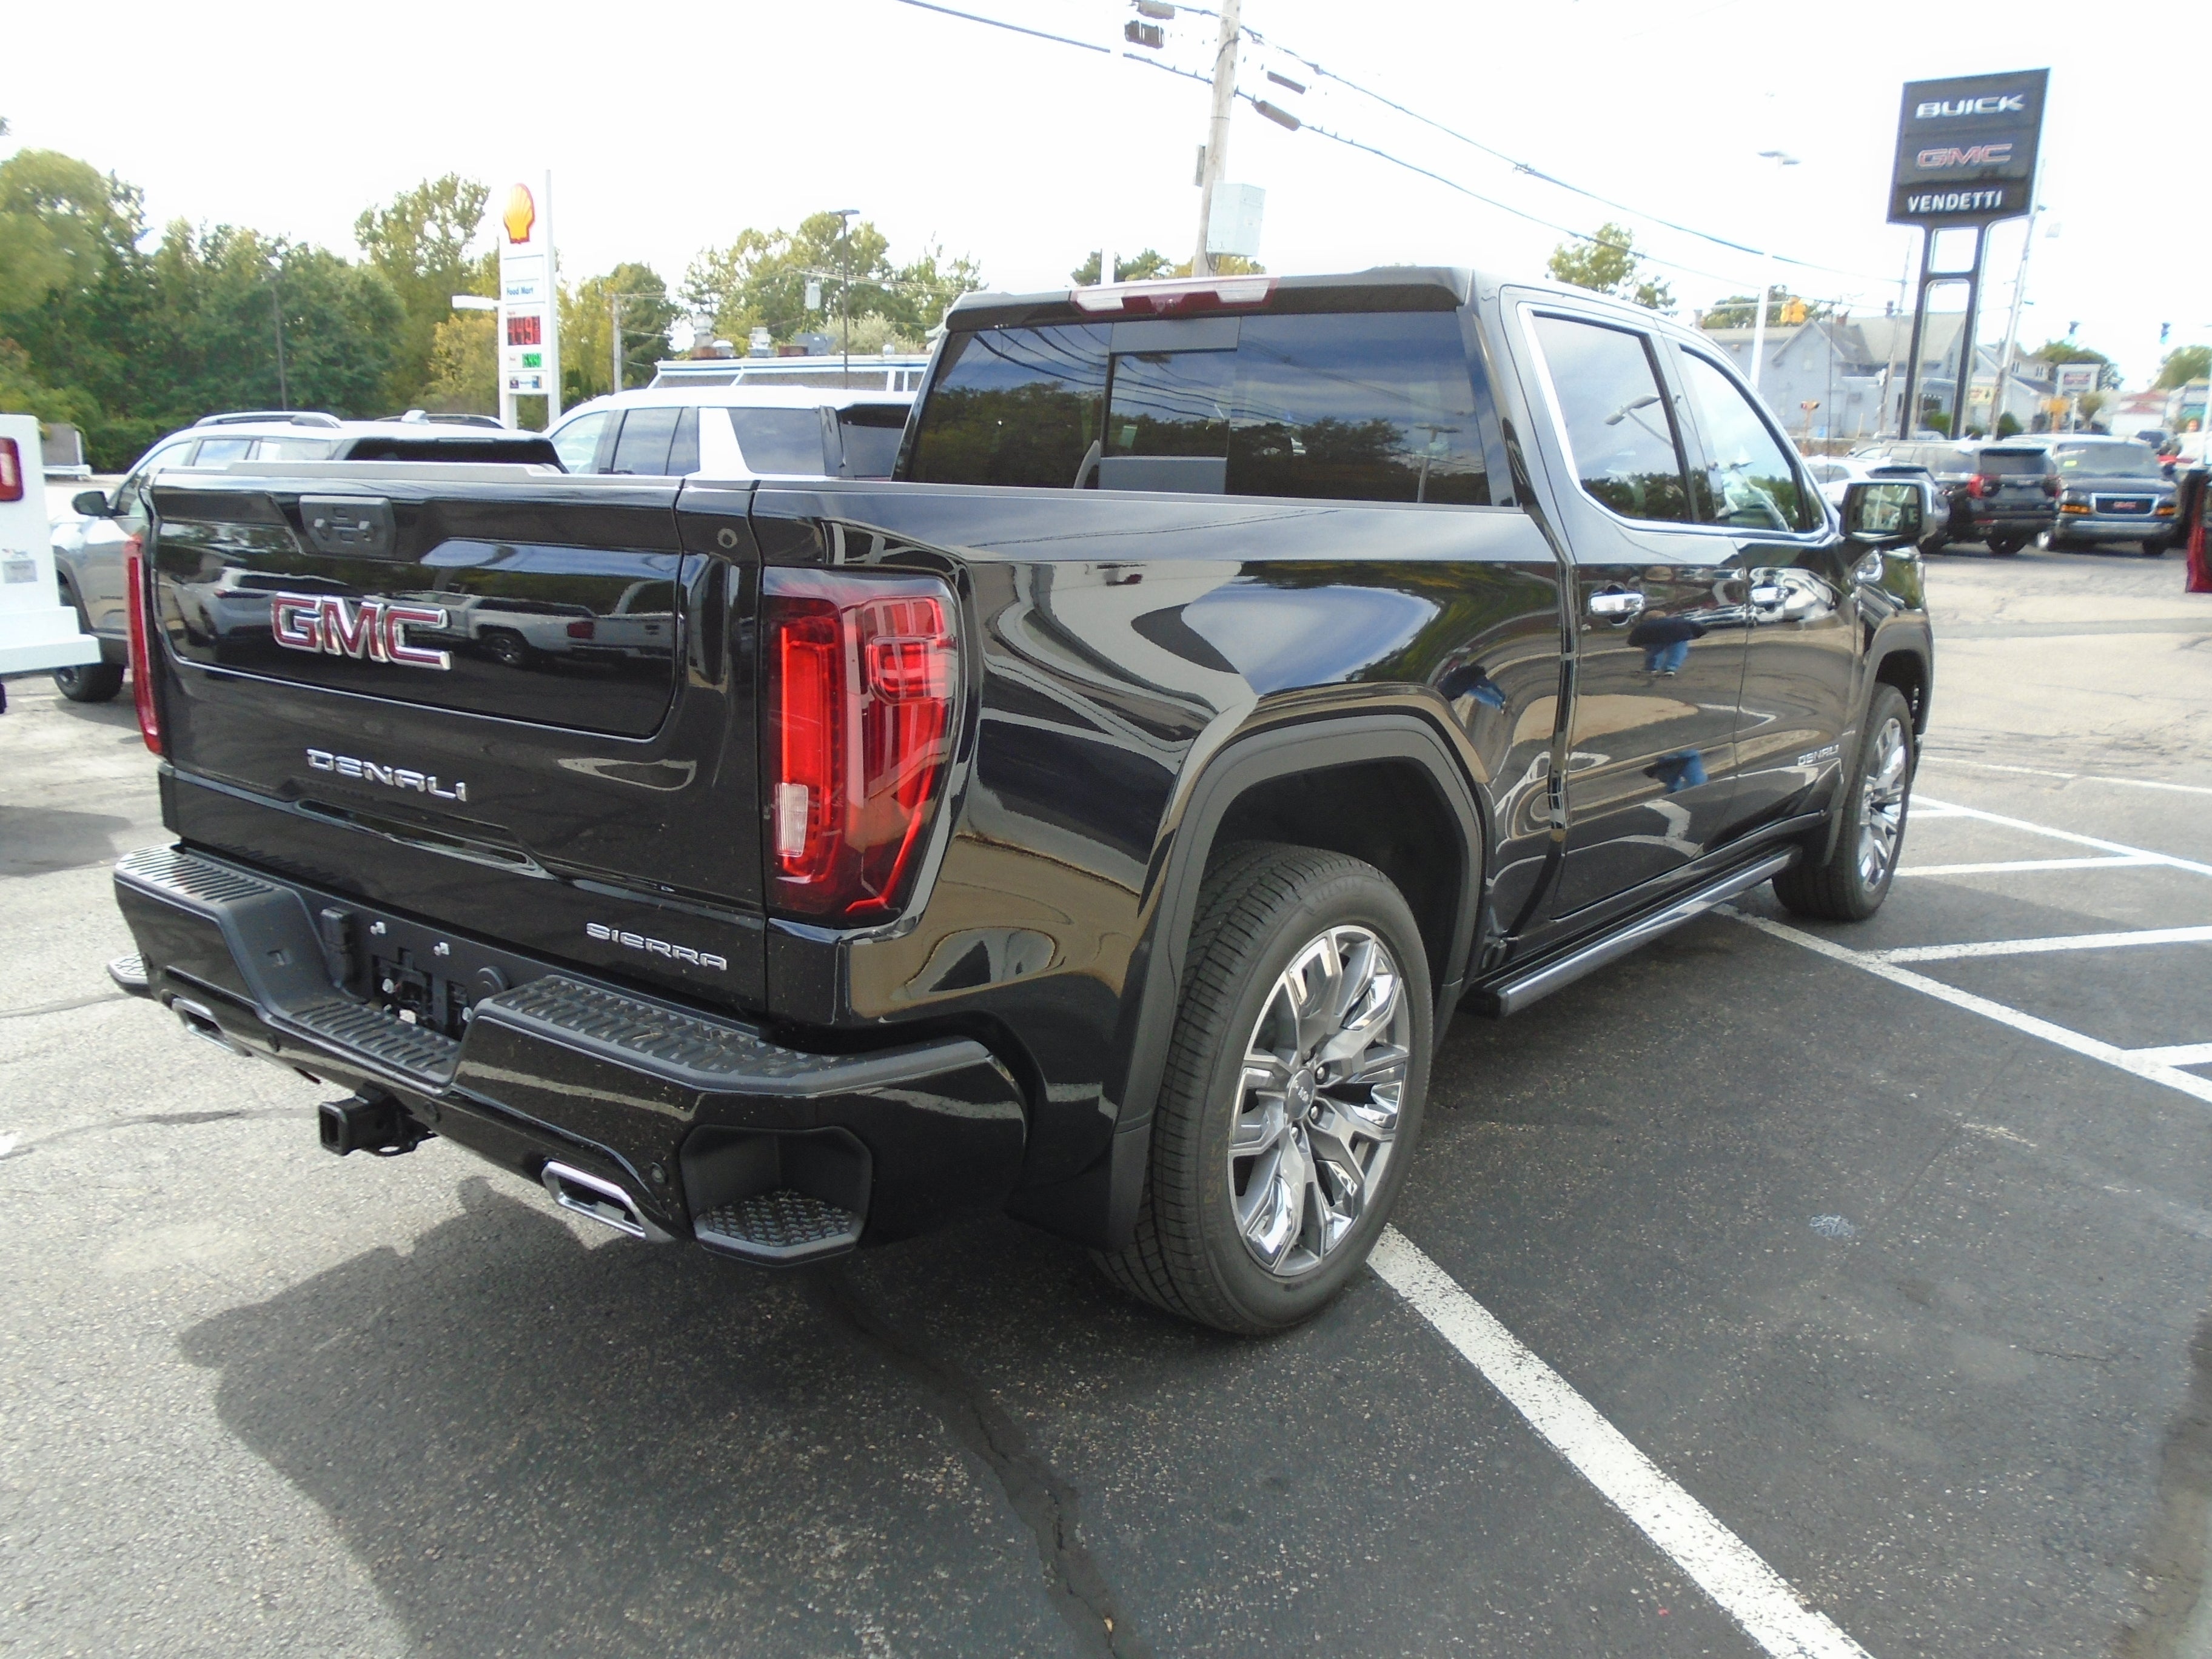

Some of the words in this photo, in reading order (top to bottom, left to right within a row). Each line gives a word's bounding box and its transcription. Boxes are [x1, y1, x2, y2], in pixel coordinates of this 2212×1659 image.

[1915, 94, 2026, 118] BUICK
[1917, 143, 2013, 169] GMC
[1908, 190, 2003, 212] VENDETTI
[271, 591, 453, 671] GMC
[1797, 744, 1839, 766] DENALI
[307, 748, 468, 802] DENALI
[586, 922, 728, 971] SIERRA
